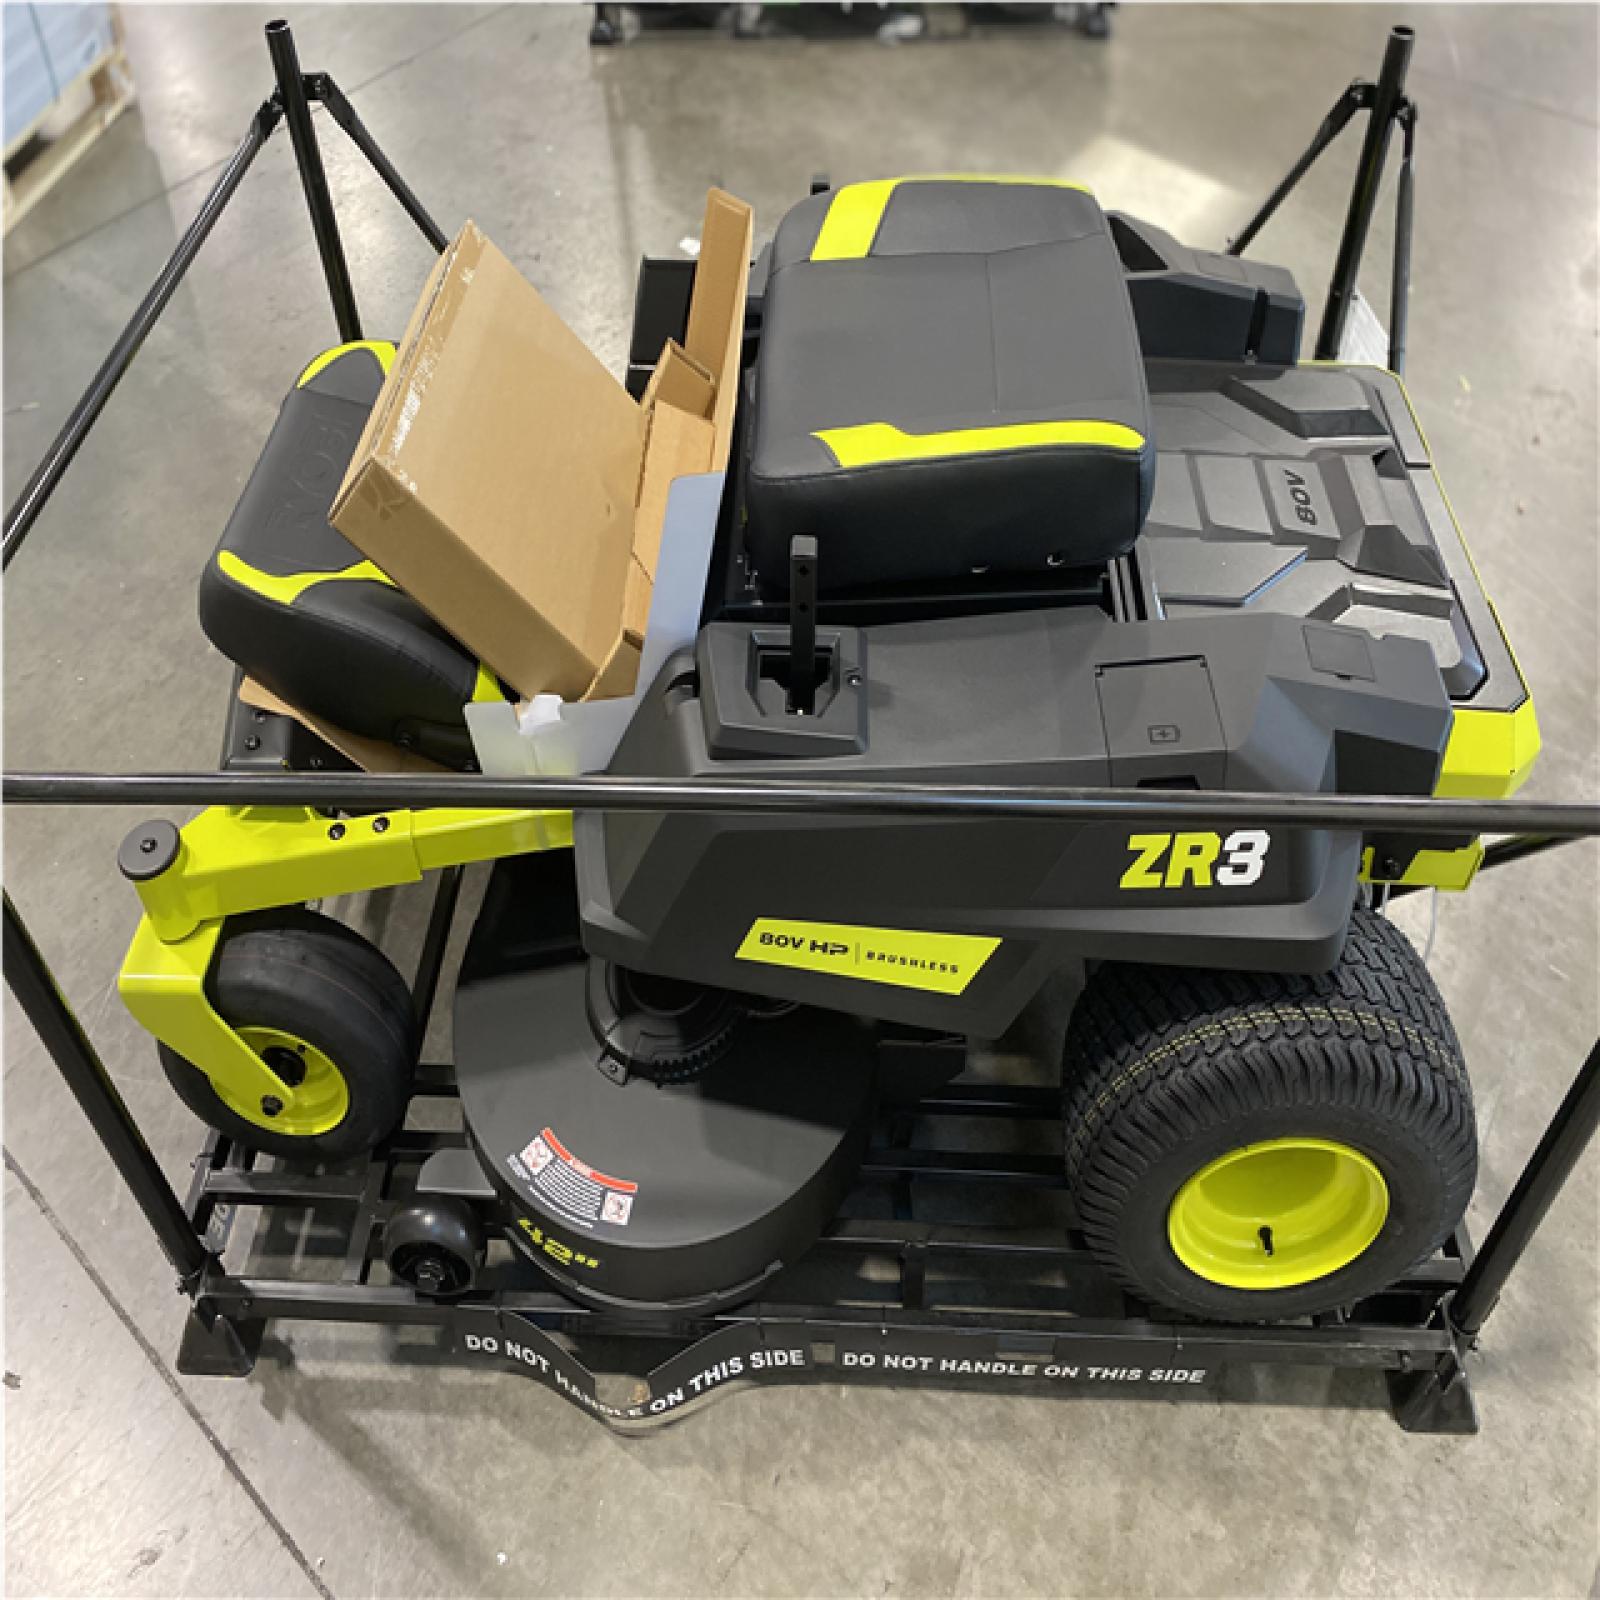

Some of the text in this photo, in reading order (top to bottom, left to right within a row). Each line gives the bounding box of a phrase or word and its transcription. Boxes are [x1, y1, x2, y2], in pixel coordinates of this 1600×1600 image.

[1284, 469, 1317, 525] 80V
[1119, 829, 1271, 888] ZR3
[760, 932, 804, 949] 80V
[810, 940, 849, 955] HP
[465, 1334, 499, 1353] DO
[505, 1340, 550, 1373] NOT
[650, 1386, 685, 1412] ON
[688, 1356, 744, 1391] THIS
[749, 1349, 806, 1369] SIDE
[843, 1352, 1206, 1383] DO NOT HANDLE ON THIS SIDE
